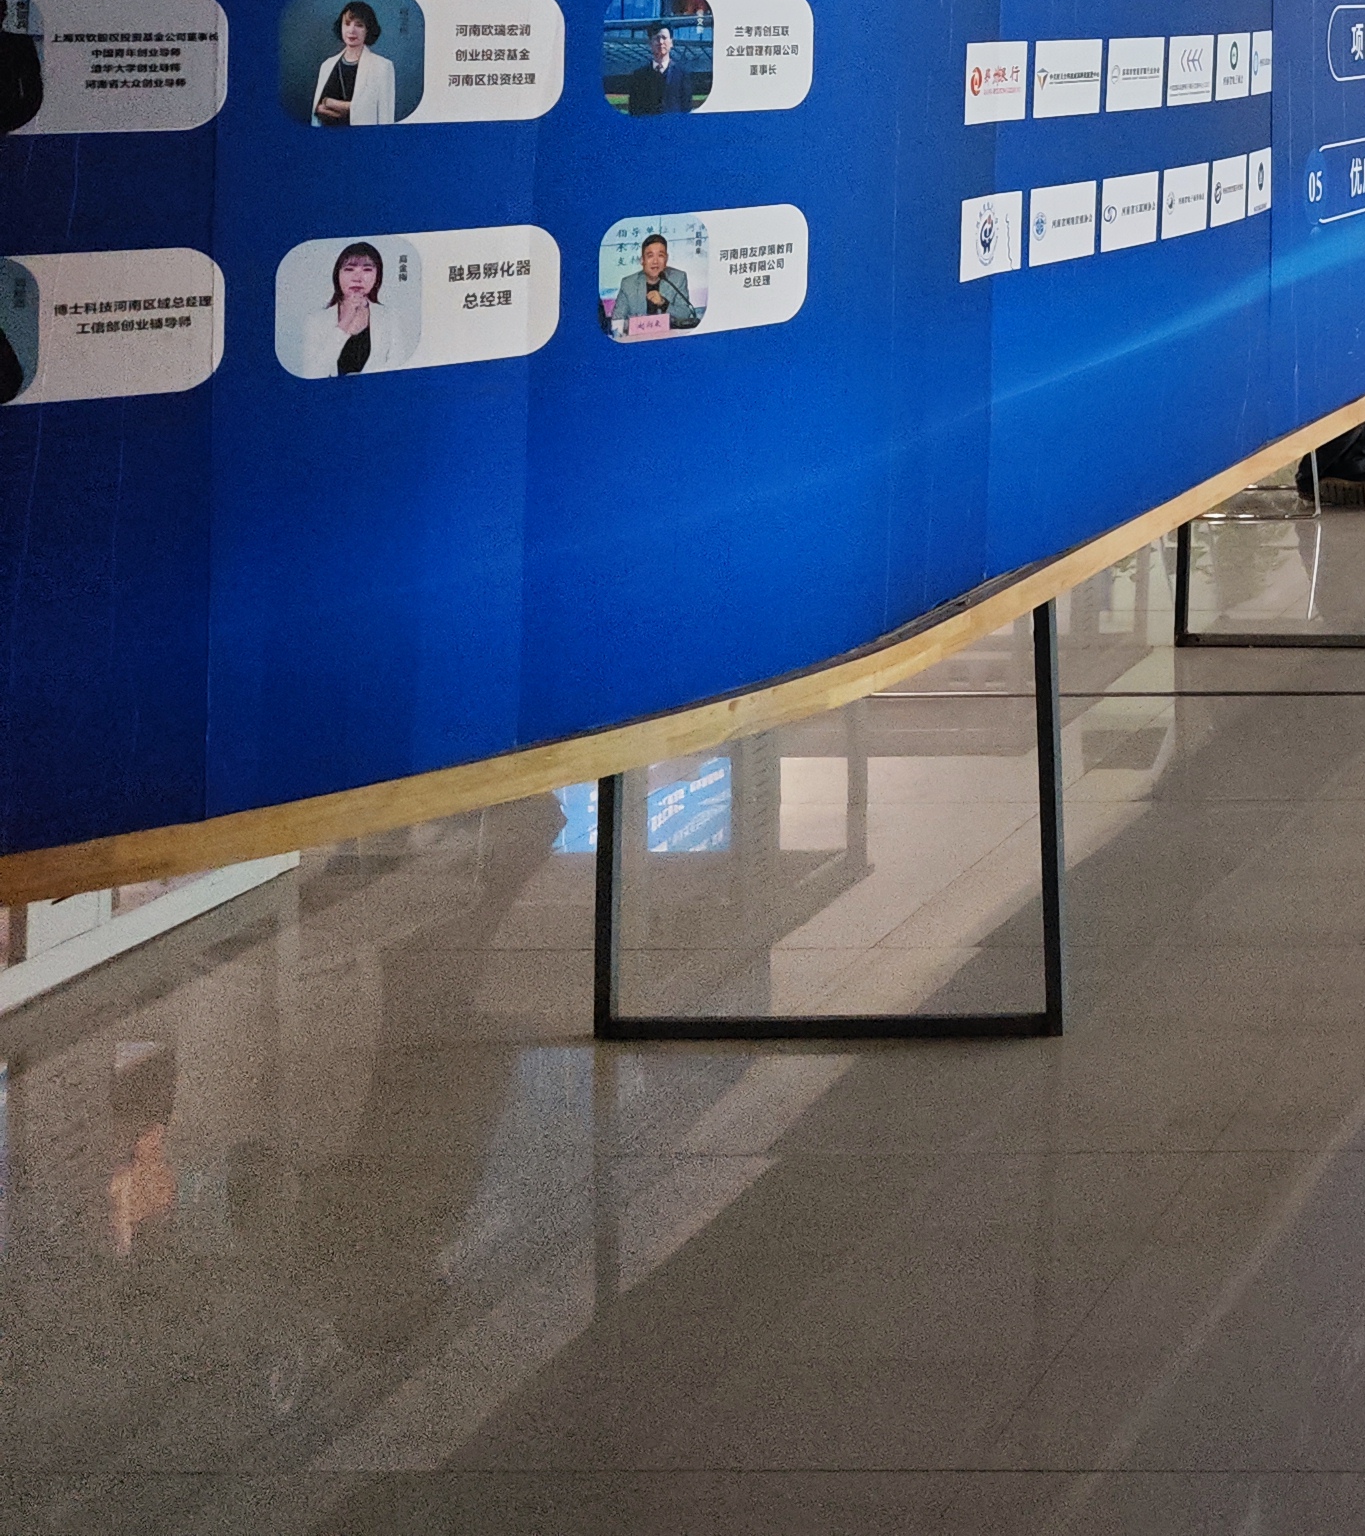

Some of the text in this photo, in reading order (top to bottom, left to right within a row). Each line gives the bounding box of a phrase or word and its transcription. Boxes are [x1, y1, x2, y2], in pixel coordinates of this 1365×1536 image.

[455, 48, 531, 63] 创业投资基金
[448, 73, 537, 87] 河南区投资经理
[1307, 170, 1323, 203] 05
[448, 259, 532, 283] 融易孵化器
[462, 289, 513, 309] 总经理
